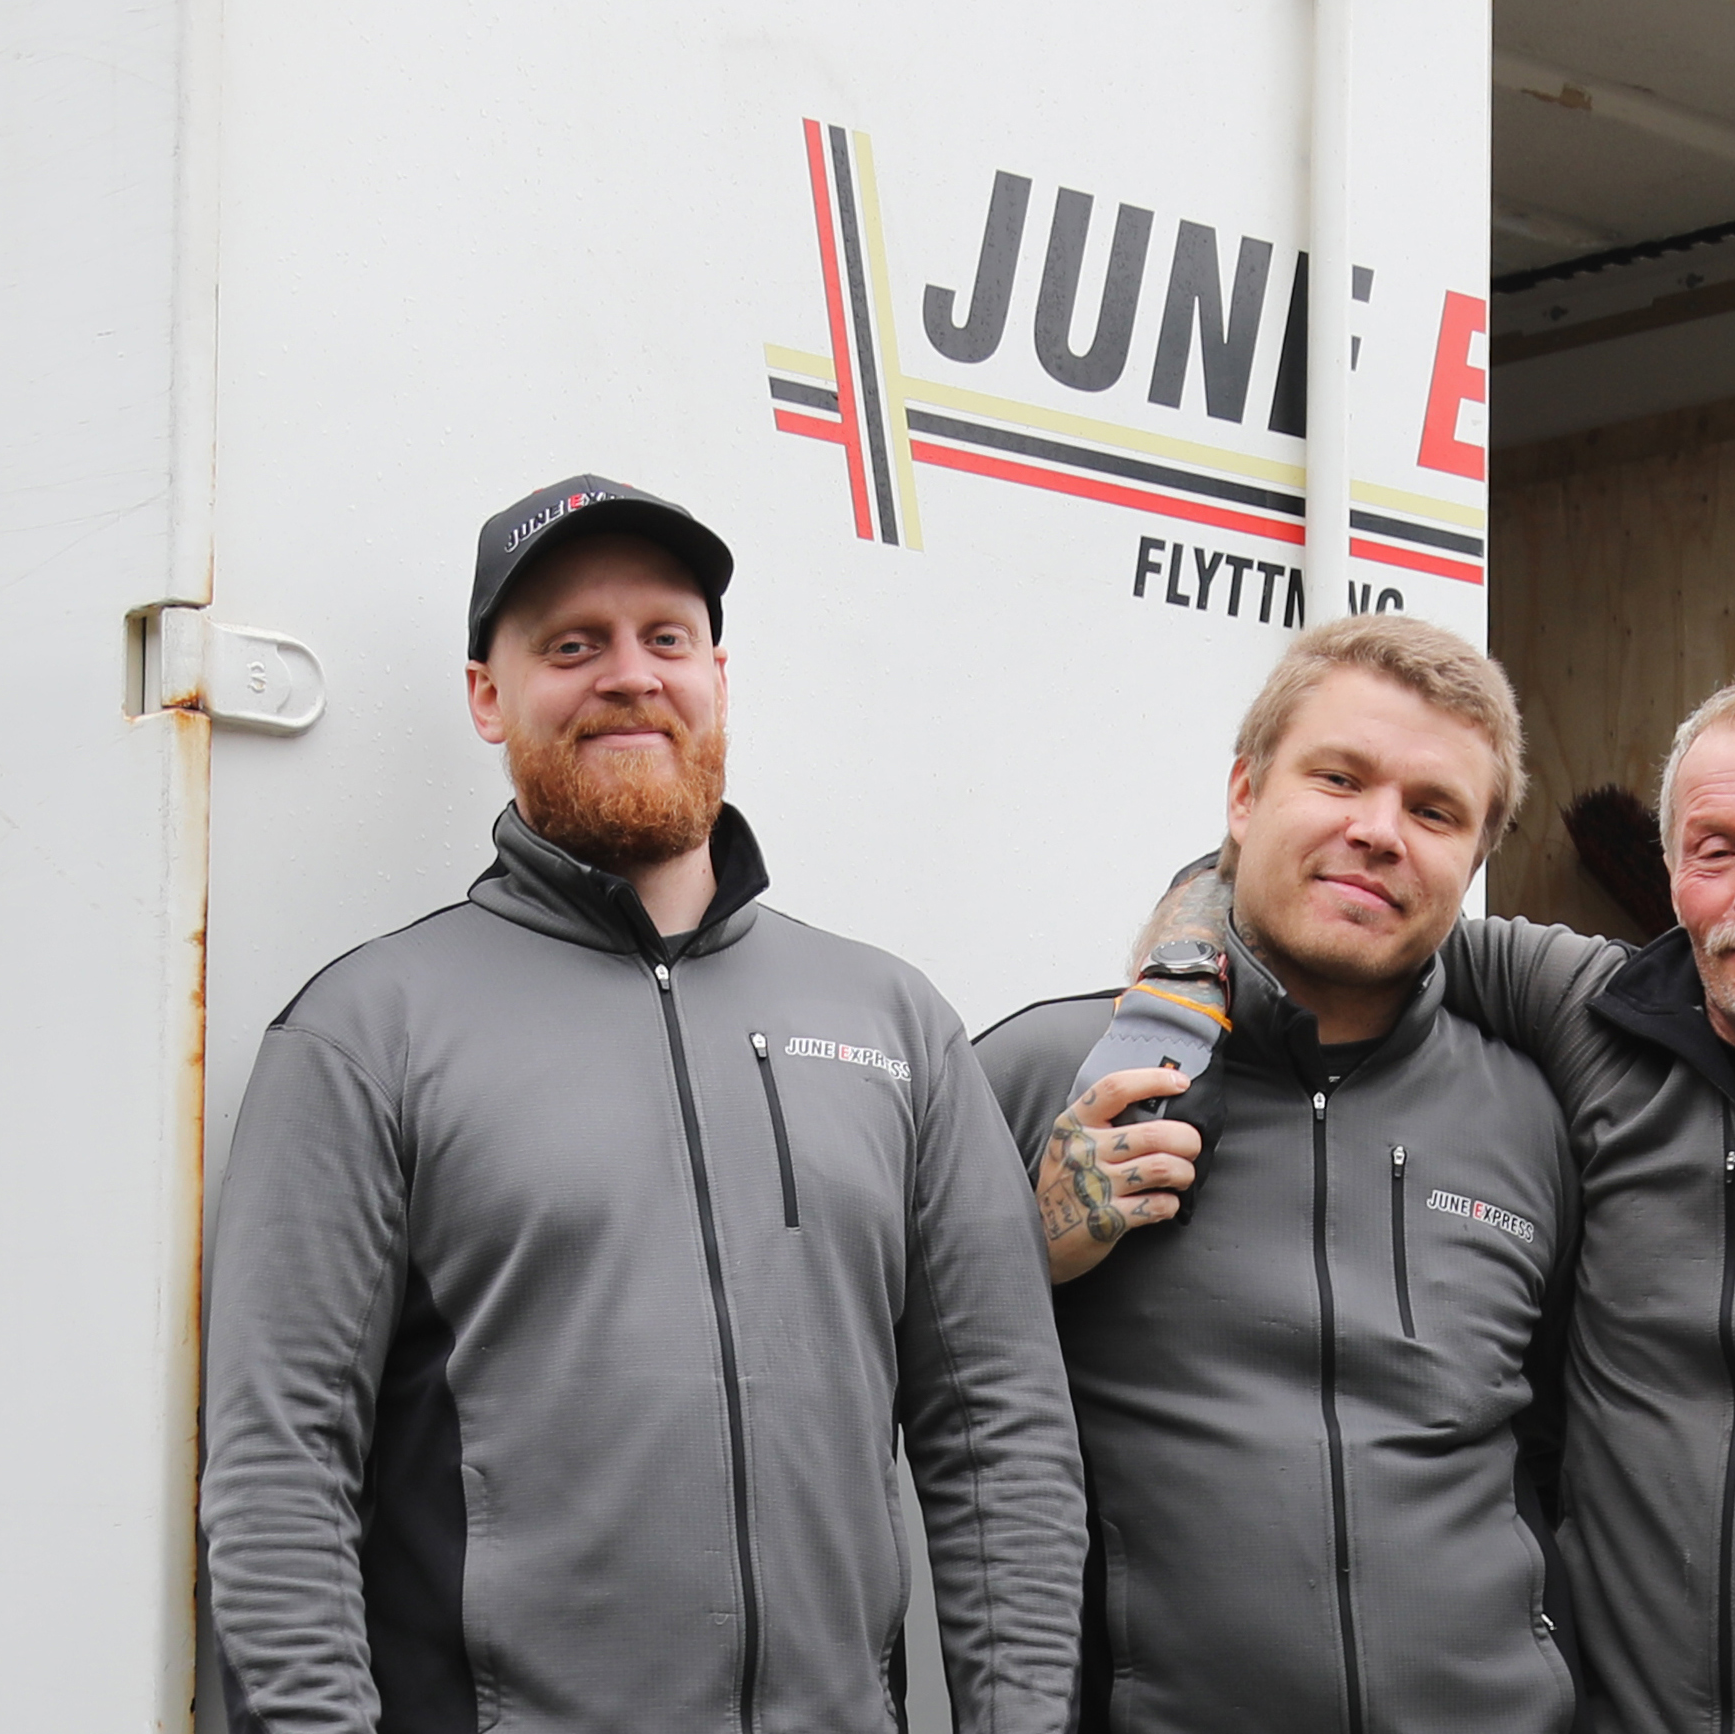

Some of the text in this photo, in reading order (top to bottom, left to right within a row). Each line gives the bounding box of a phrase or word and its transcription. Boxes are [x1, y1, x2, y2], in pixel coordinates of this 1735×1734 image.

[1133, 535, 1404, 631] FLYTTN
[785, 1037, 836, 1060] JUNE
[1426, 1189, 1535, 1243] JUNE EXPRESS
